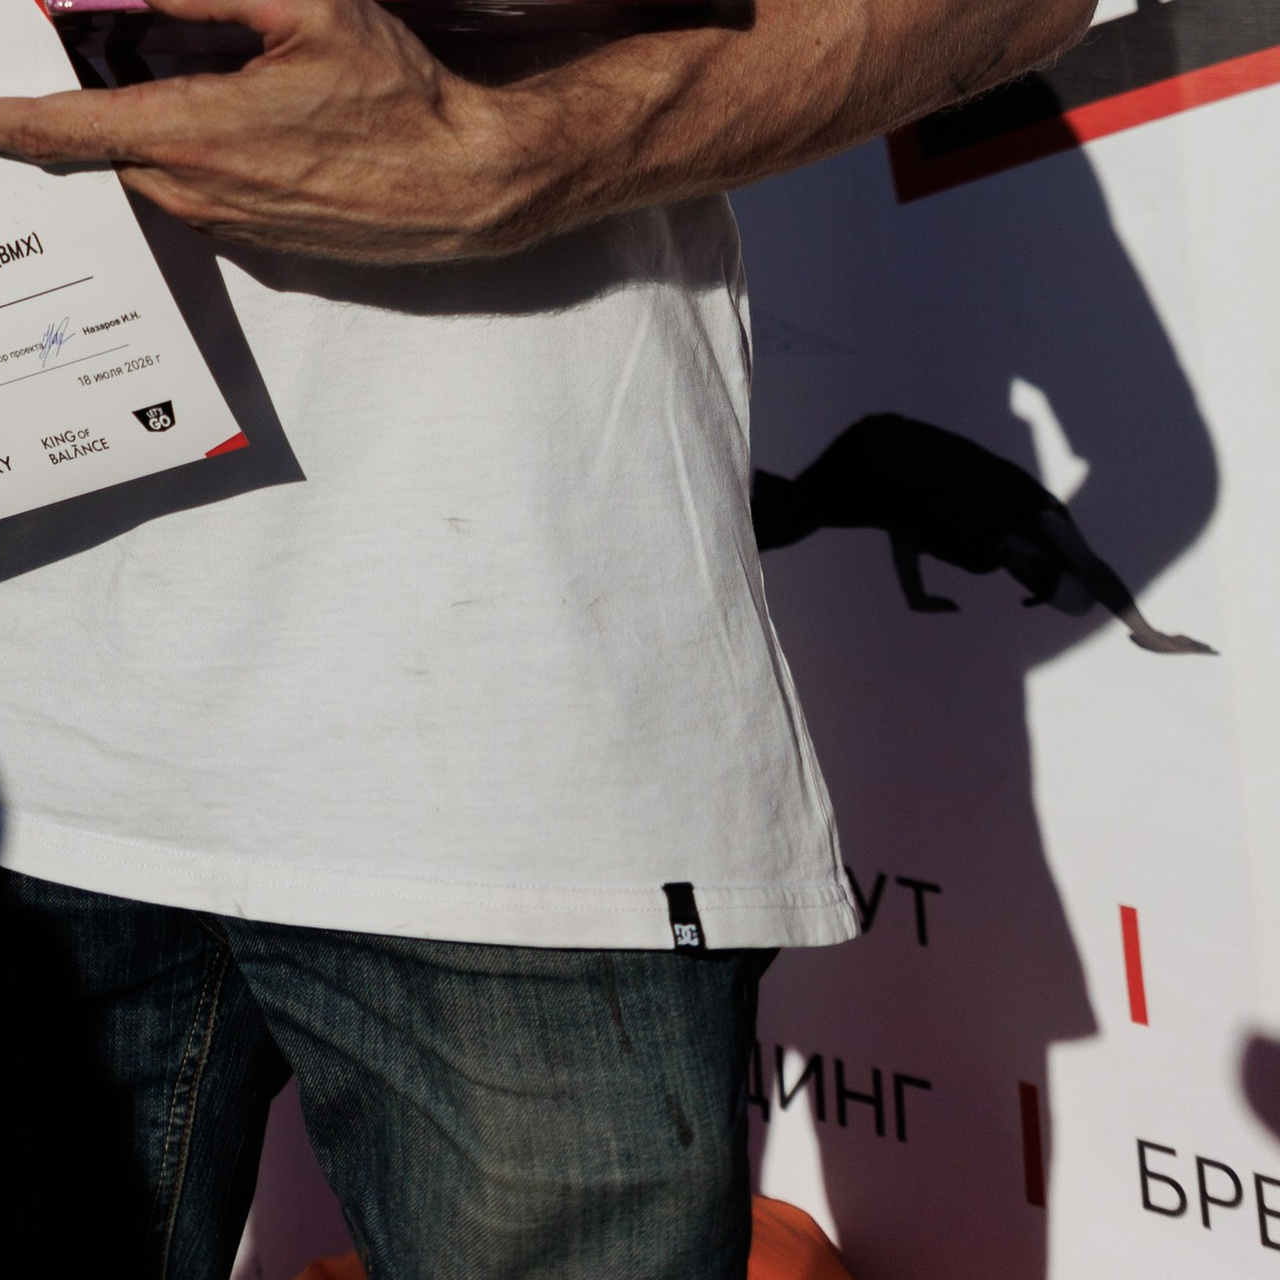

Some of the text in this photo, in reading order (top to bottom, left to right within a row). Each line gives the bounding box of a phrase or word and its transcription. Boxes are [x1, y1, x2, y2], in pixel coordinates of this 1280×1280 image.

[9, 341, 45, 362] проекта
[81, 318, 121, 337] Назаров
[121, 311, 142, 325] И.Н.
[78, 374, 92, 387] 18
[93, 366, 124, 384] июля
[124, 355, 154, 374] 2026
[149, 414, 172, 431] GO
[40, 428, 91, 451] KING OF
